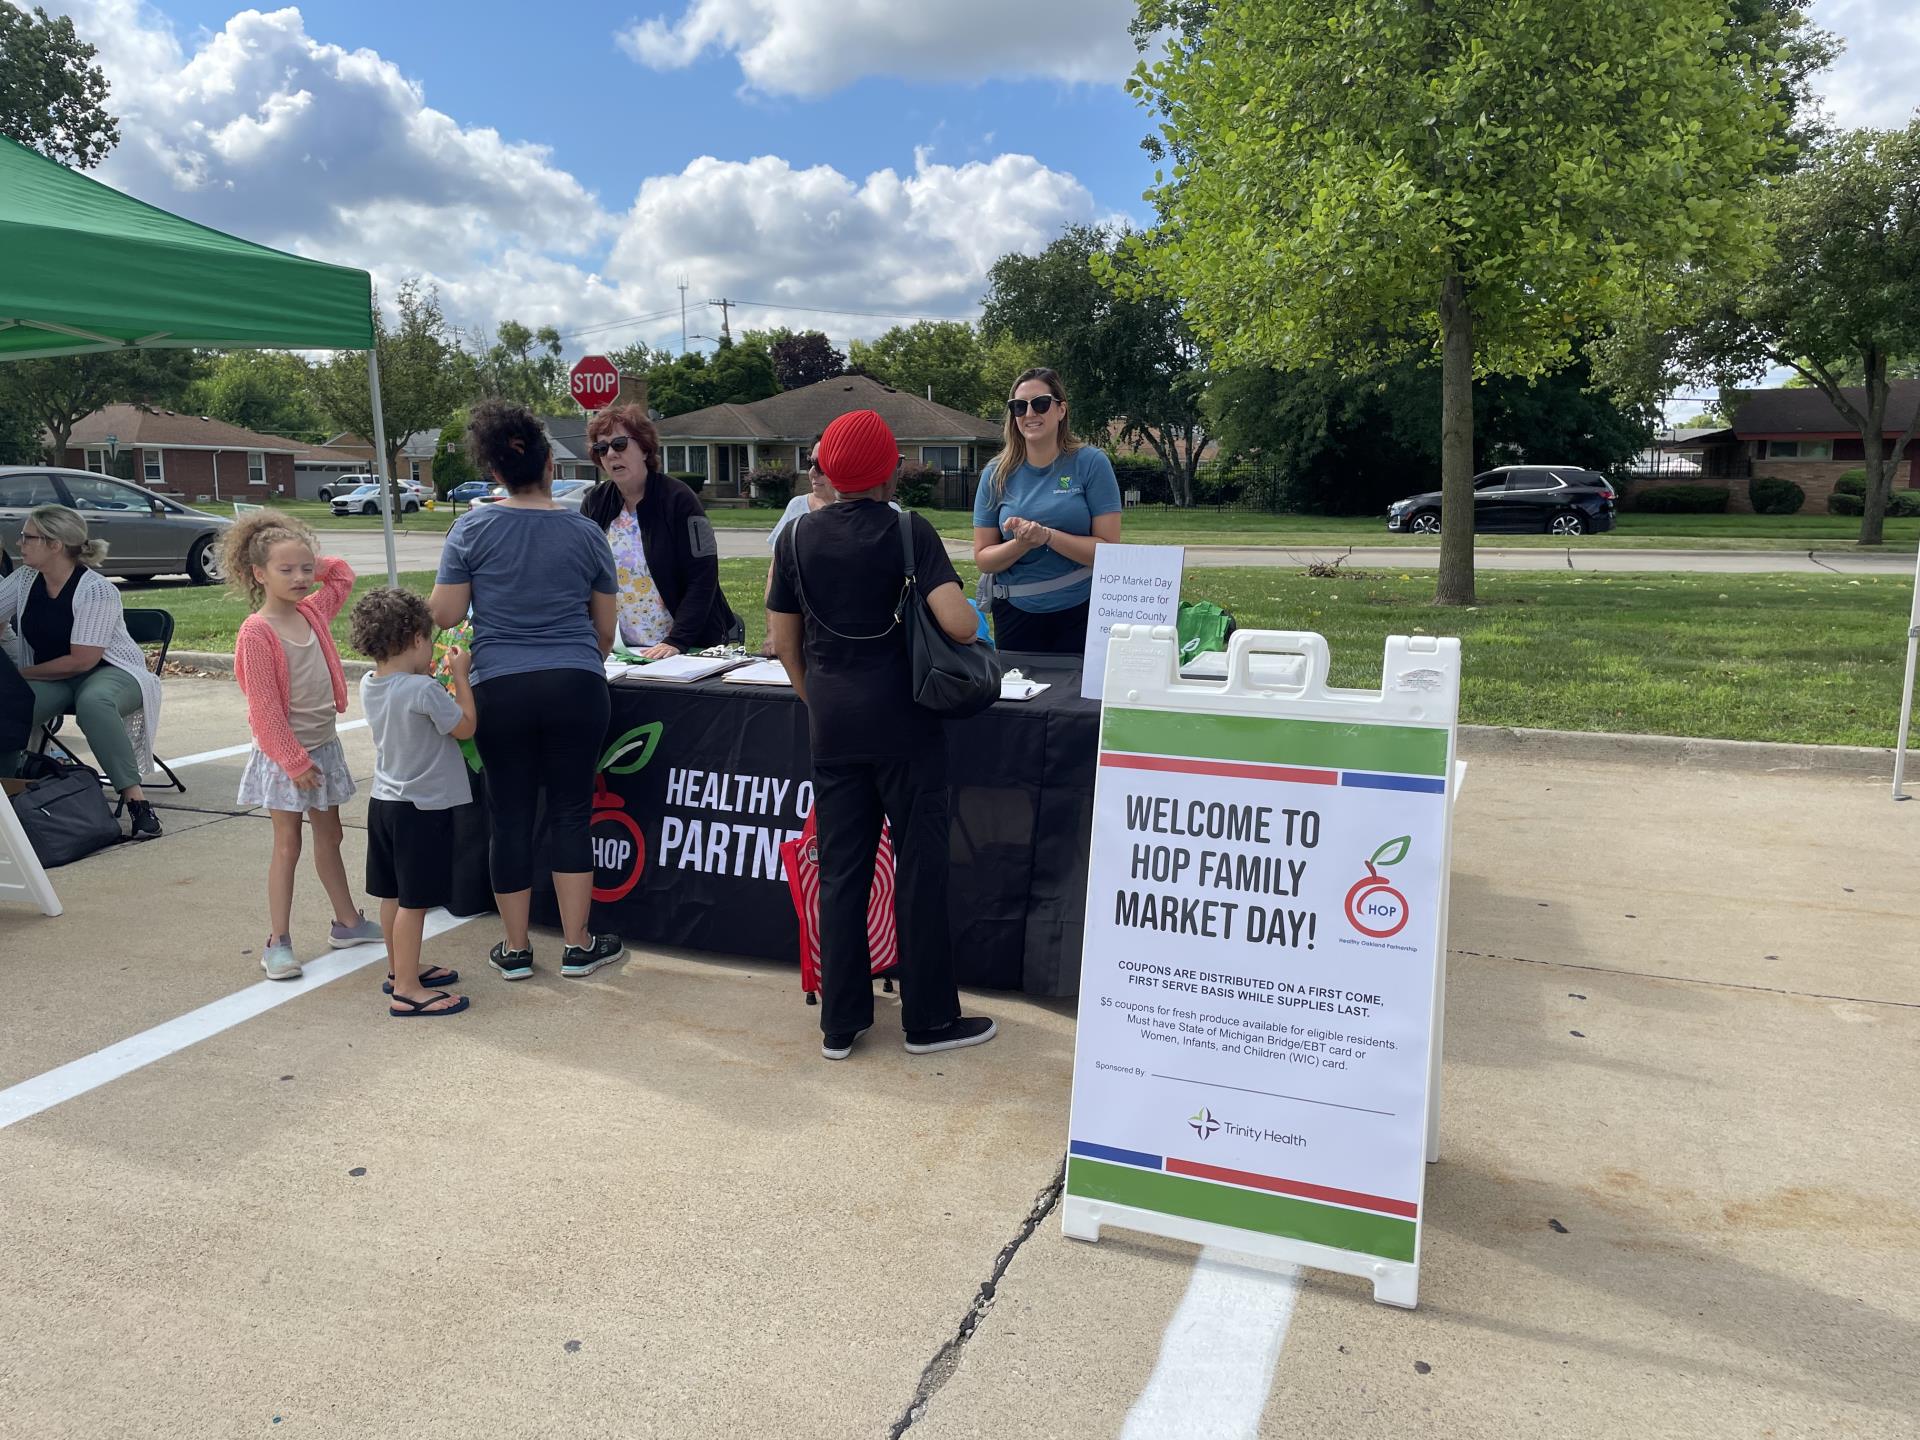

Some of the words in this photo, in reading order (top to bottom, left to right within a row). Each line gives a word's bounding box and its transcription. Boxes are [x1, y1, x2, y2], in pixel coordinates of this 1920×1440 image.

[573, 373, 616, 393] STOP
[1100, 574, 1120, 584] HOP
[1123, 576, 1152, 586] Market
[1155, 578, 1172, 589] Day
[1098, 607, 1133, 619] Oakland
[1136, 611, 1167, 623] County
[1102, 593, 1138, 603] coupons
[1140, 595, 1155, 603] are
[1157, 595, 1169, 604] for
[1100, 625, 1112, 634] res
[666, 768, 790, 816] HEALTHY
[796, 781, 815, 819] O
[1127, 794, 1272, 844] WELCOME
[1282, 808, 1320, 848] TO
[592, 837, 630, 870] HOP
[1131, 843, 1190, 883] HOP
[1199, 851, 1307, 897] FAMILY
[1115, 890, 1239, 939] MARKET
[1247, 905, 1316, 950] DAY!
[1368, 904, 1396, 917] HOP
[1361, 940, 1385, 949] Oakland
[1387, 943, 1418, 953] Partnership
[1118, 960, 1171, 976] COUPONS
[1174, 969, 1197, 980] ARE
[1200, 972, 1274, 990] DISTRIBUTED
[1278, 982, 1295, 993] ON
[1297, 985, 1306, 994] A
[1309, 986, 1342, 999] FIRST
[1346, 991, 1384, 1007] COME,
[1129, 975, 1159, 987] FIRST
[1162, 980, 1198, 993] SERVE
[1201, 986, 1235, 998] BASIS
[1238, 991, 1274, 1004] WHILE
[1277, 996, 1334, 1012] SUPPLIES
[1338, 1004, 1370, 1018] LAST.
[1100, 997, 1113, 1007] $5
[1115, 1000, 1155, 1013] coupons
[1157, 1005, 1170, 1015] for
[1173, 1008, 1196, 1020] fresh
[1200, 1013, 1240, 1027] produce
[1242, 1020, 1287, 1033] available
[1291, 1025, 1304, 1035] for
[1307, 1028, 1343, 1042] eligible
[1346, 1035, 1398, 1050] residents.
[1127, 1014, 1150, 1026] Must
[1153, 1018, 1175, 1030] have
[1179, 1022, 1204, 1034] State
[1207, 1027, 1217, 1036] of
[1220, 1029, 1264, 1044] Michigan
[1267, 1035, 1326, 1053] Bridge/EBT
[1329, 1046, 1351, 1057] card
[1355, 1050, 1366, 1059] or
[1140, 1029, 1180, 1045] Women,
[1184, 1036, 1218, 1051] Infants,
[1222, 1044, 1240, 1054] and
[1244, 1045, 1286, 1060] Children
[1289, 1052, 1319, 1067] (WIC)
[1322, 1058, 1348, 1070] card.
[1096, 1061, 1133, 1074] Sponsored
[1224, 1121, 1262, 1142] Trinity
[1264, 1129, 1307, 1147] Health
